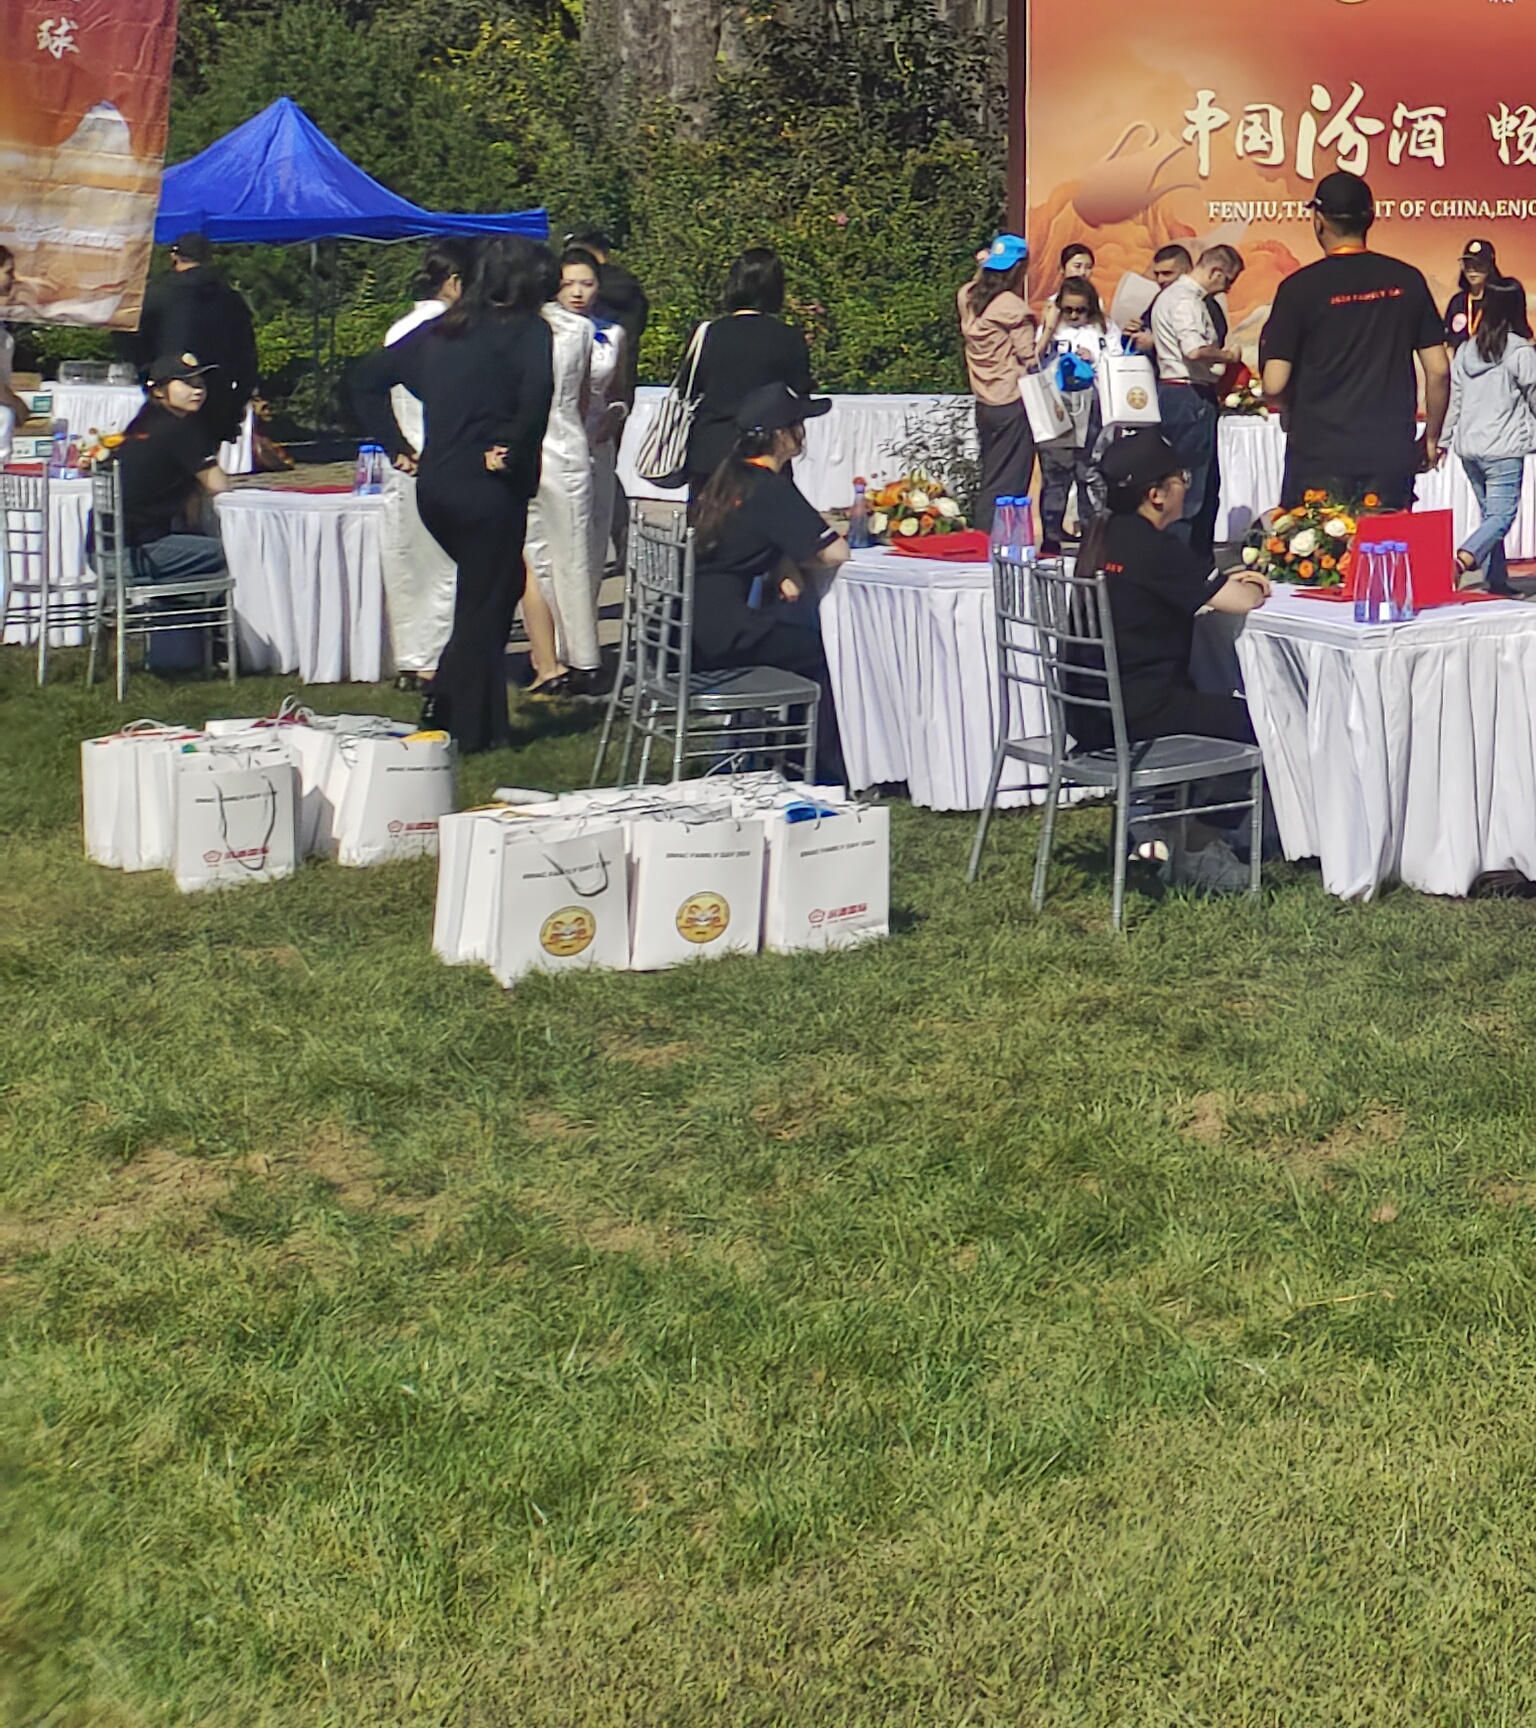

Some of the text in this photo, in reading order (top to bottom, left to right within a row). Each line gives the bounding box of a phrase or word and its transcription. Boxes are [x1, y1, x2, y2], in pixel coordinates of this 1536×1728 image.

[1181, 81, 1448, 179] 中国汾酒
[1208, 200, 1312, 223] FENJIU,TH
[1400, 200, 1427, 218] OF
